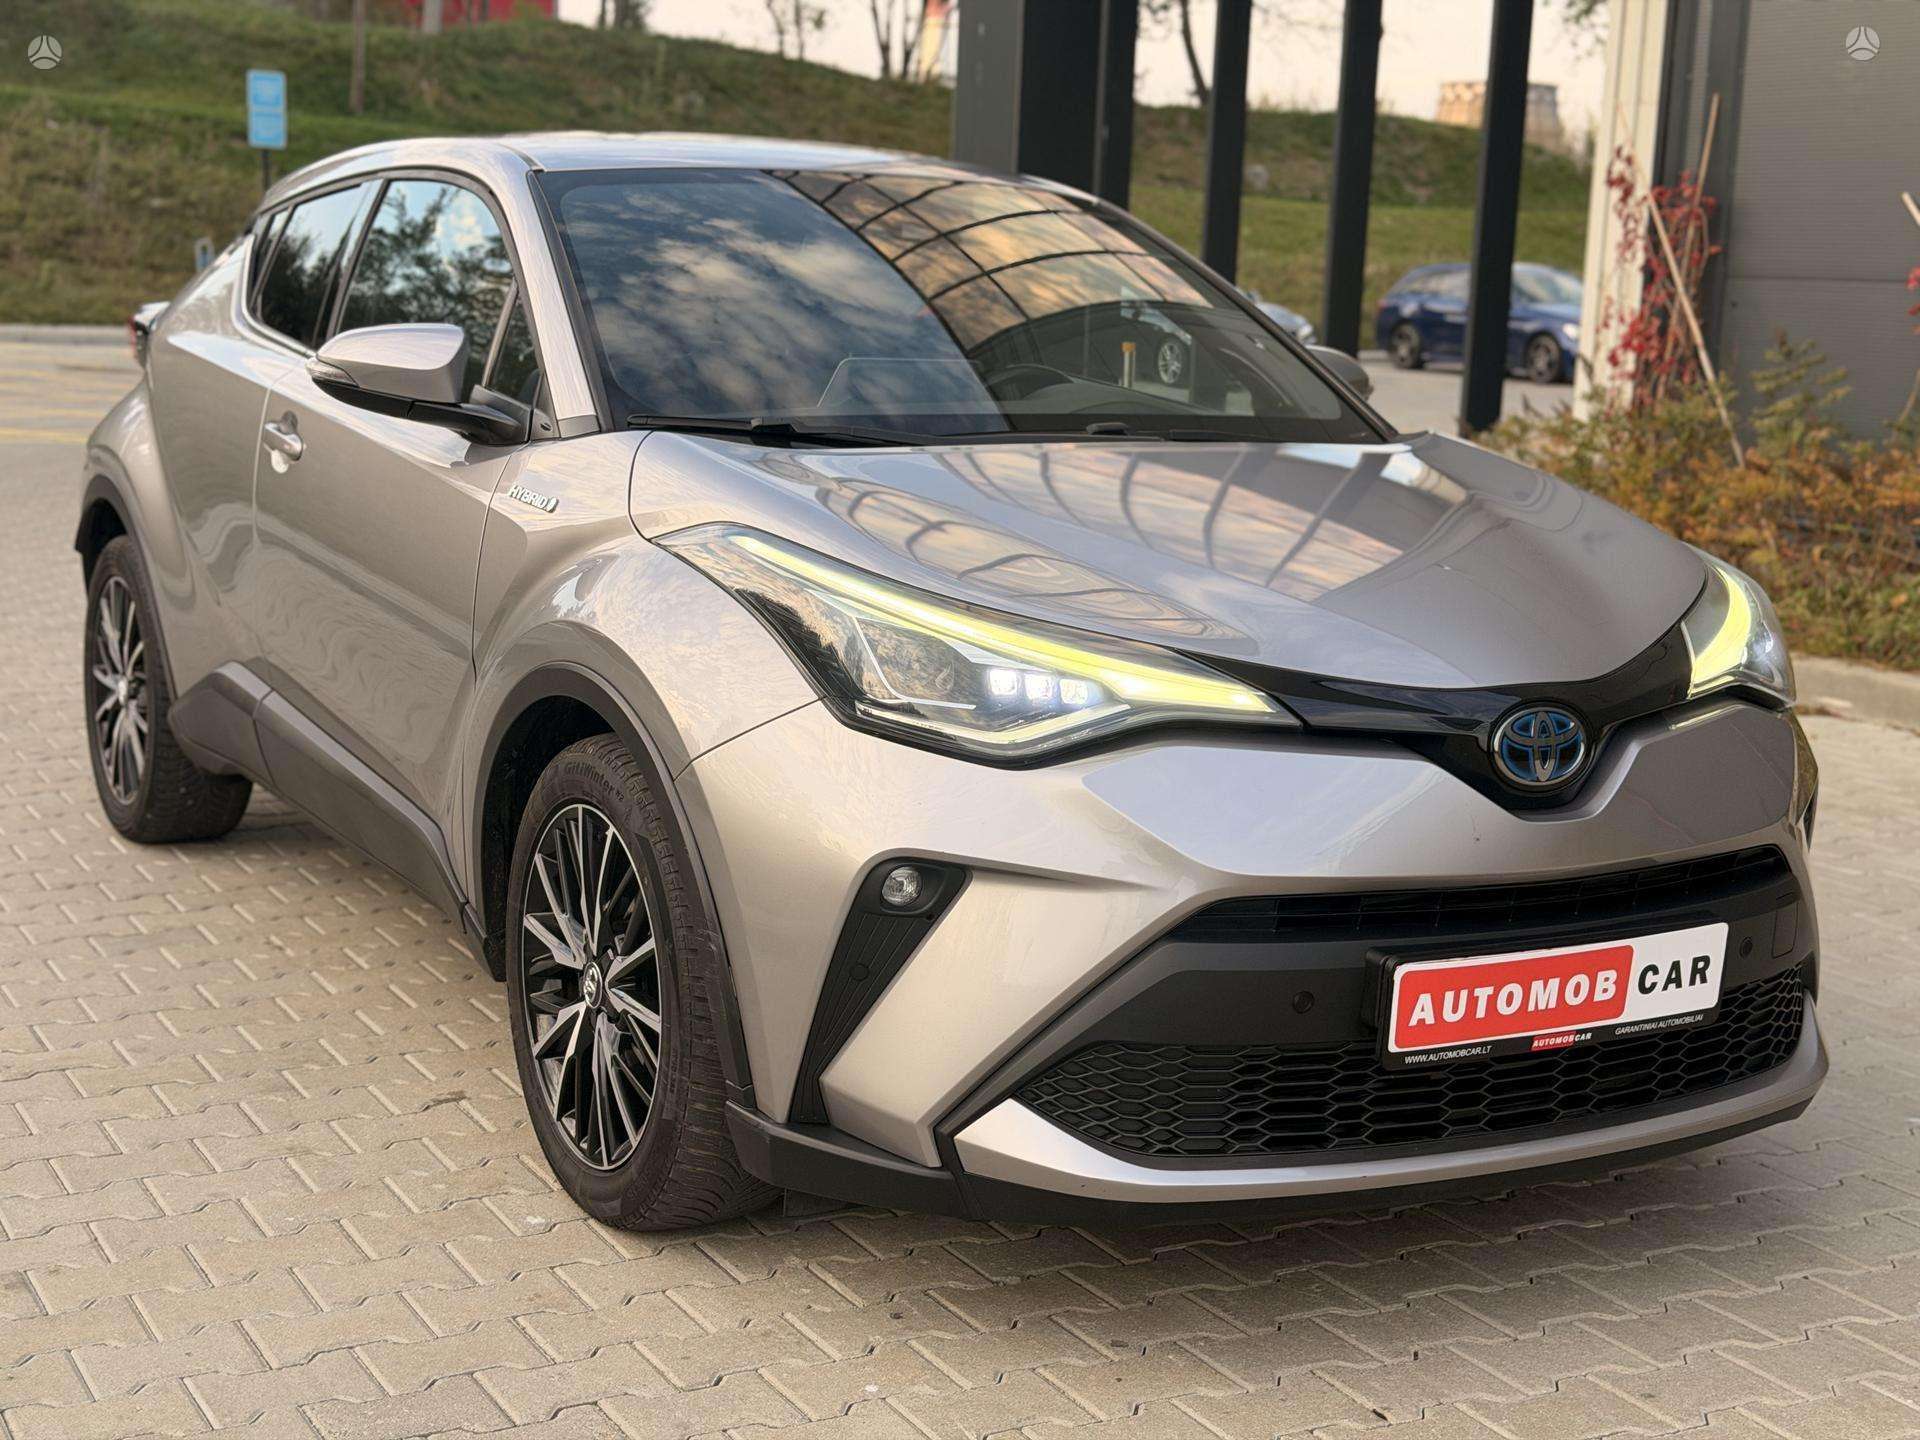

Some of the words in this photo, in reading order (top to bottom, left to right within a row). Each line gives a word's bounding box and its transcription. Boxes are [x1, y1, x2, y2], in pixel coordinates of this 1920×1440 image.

[507, 484, 548, 509] HYBRID
[1407, 968, 1618, 1027] AUTOMOB
[1637, 954, 1712, 996] CAR
[1614, 1023, 1657, 1036] GARANTINIAI
[1658, 1014, 1704, 1028] AUTOMOBILIAI
[1404, 1045, 1493, 1065] WWW.AUTOMOBCAR.LT
